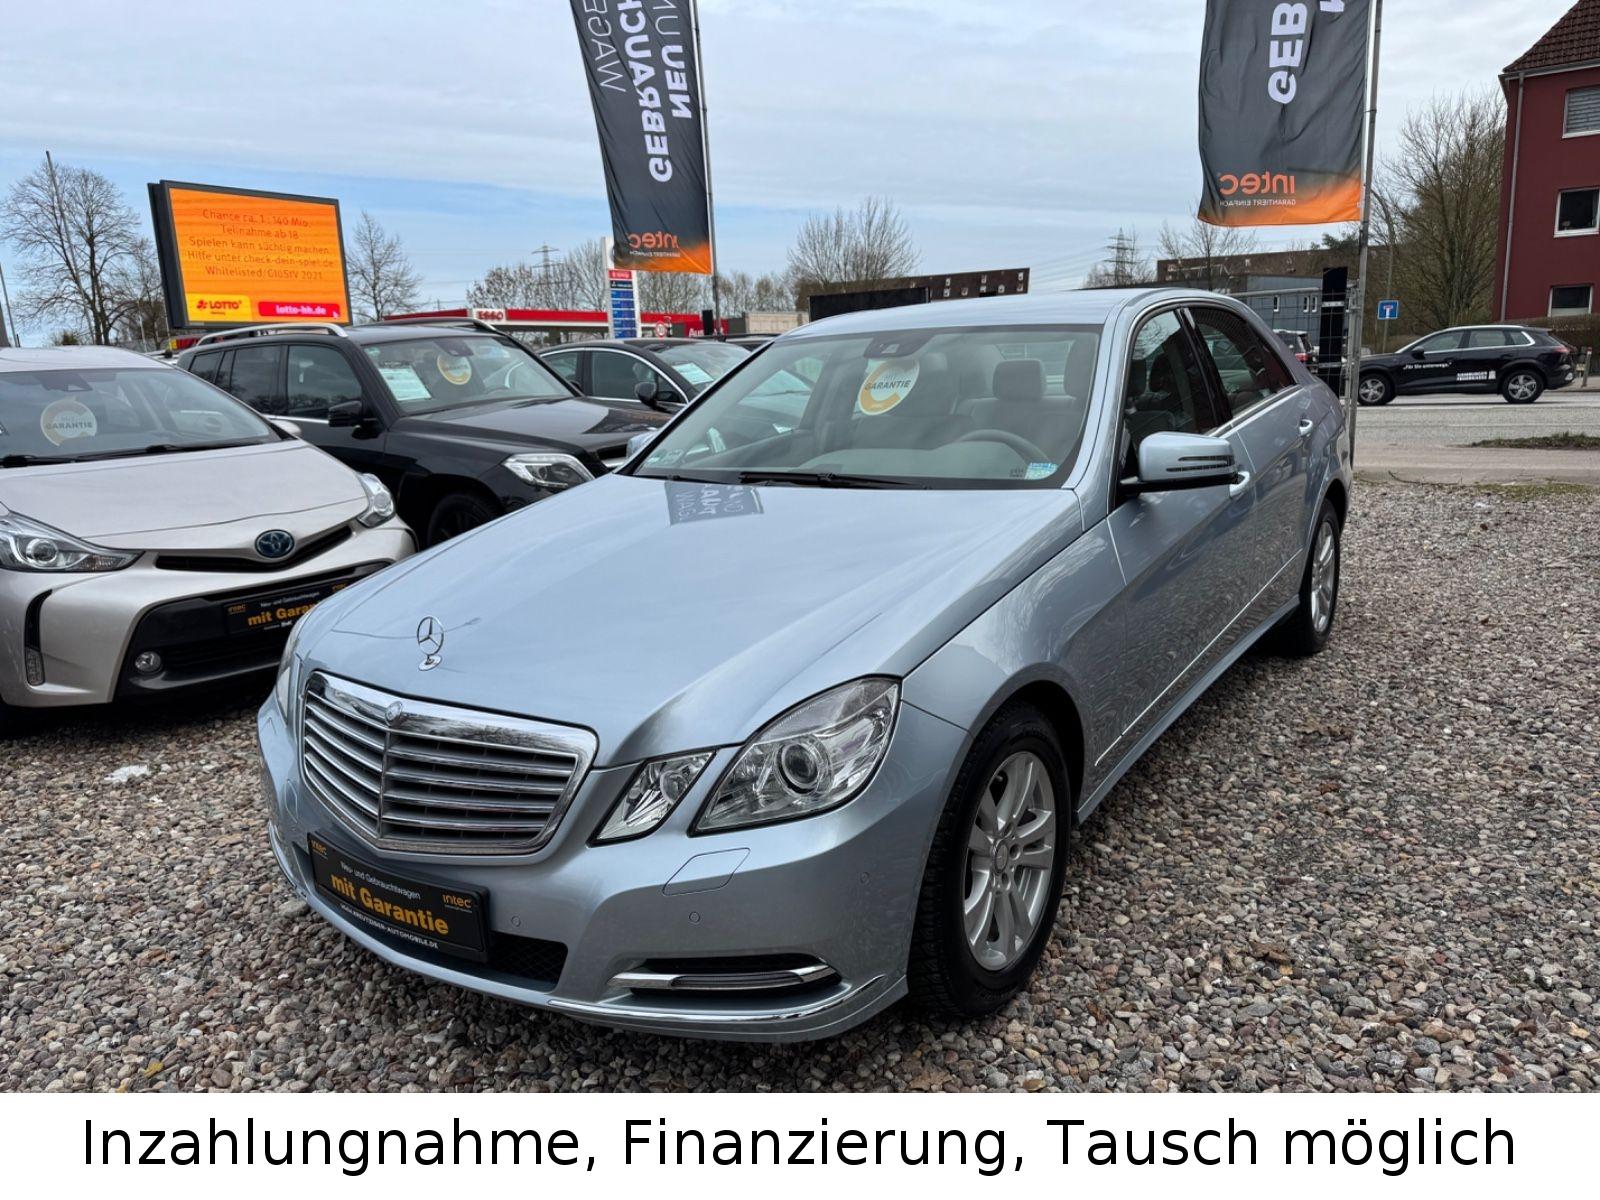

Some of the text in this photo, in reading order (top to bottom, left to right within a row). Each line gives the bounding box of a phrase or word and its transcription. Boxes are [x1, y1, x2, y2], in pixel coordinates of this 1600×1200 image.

[202, 208, 240, 222] Chance
[221, 223, 272, 238] Teilnahme
[274, 228, 287, 239] ab
[188, 236, 228, 250] Spielen
[231, 238, 255, 250] kann
[187, 250, 212, 261] Hilfe
[215, 252, 241, 263] unter
[275, 304, 327, 315] lotto-hh.de
[247, 610, 273, 626] mit
[330, 874, 449, 935] mit Garantie
[442, 893, 473, 909] intec
